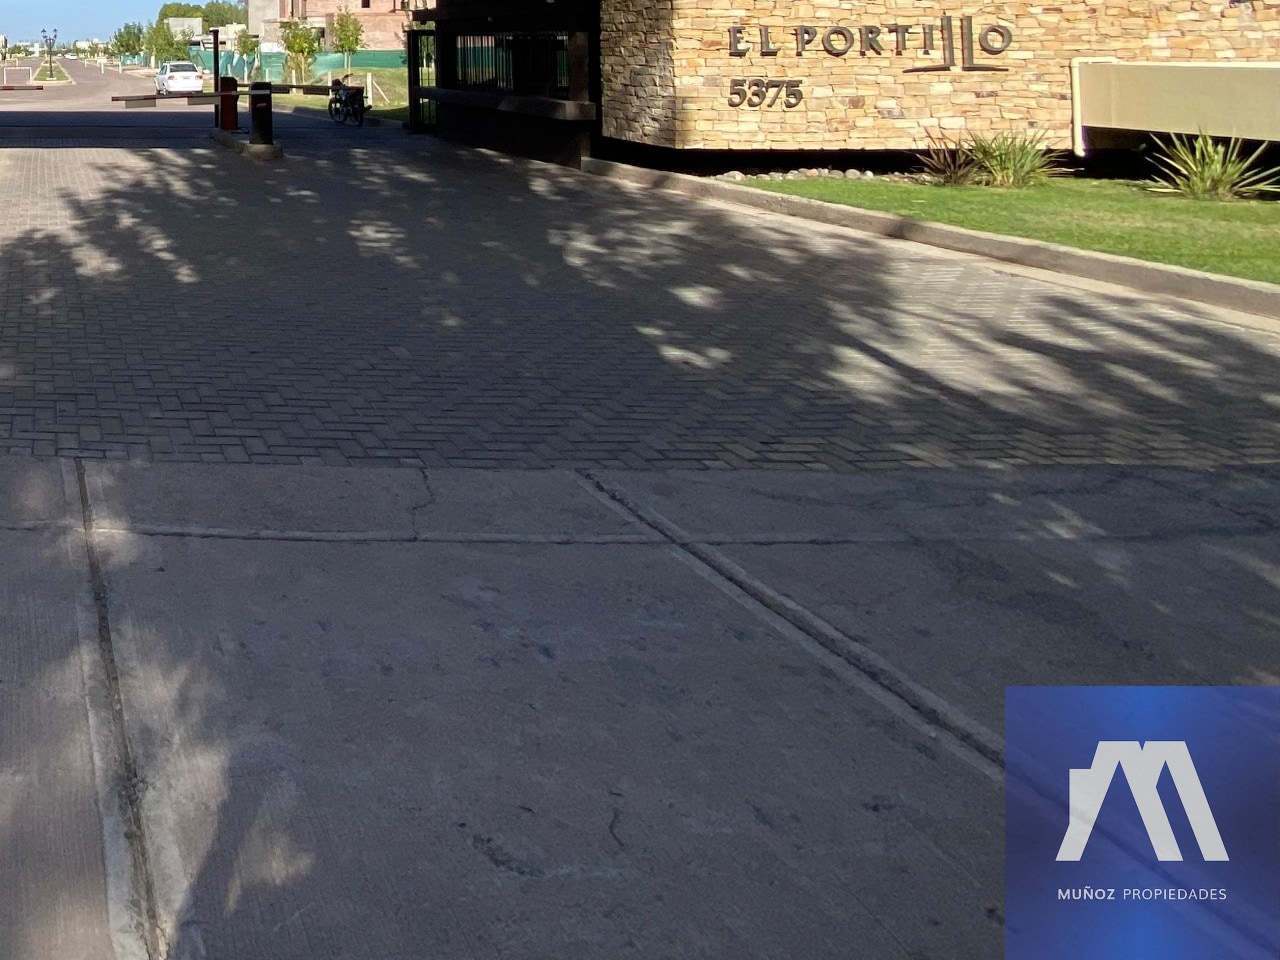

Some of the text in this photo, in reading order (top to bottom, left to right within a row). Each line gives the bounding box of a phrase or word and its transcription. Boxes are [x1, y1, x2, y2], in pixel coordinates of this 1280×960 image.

[728, 14, 1013, 73] EL PORTILLO
[728, 78, 803, 108] 5375
